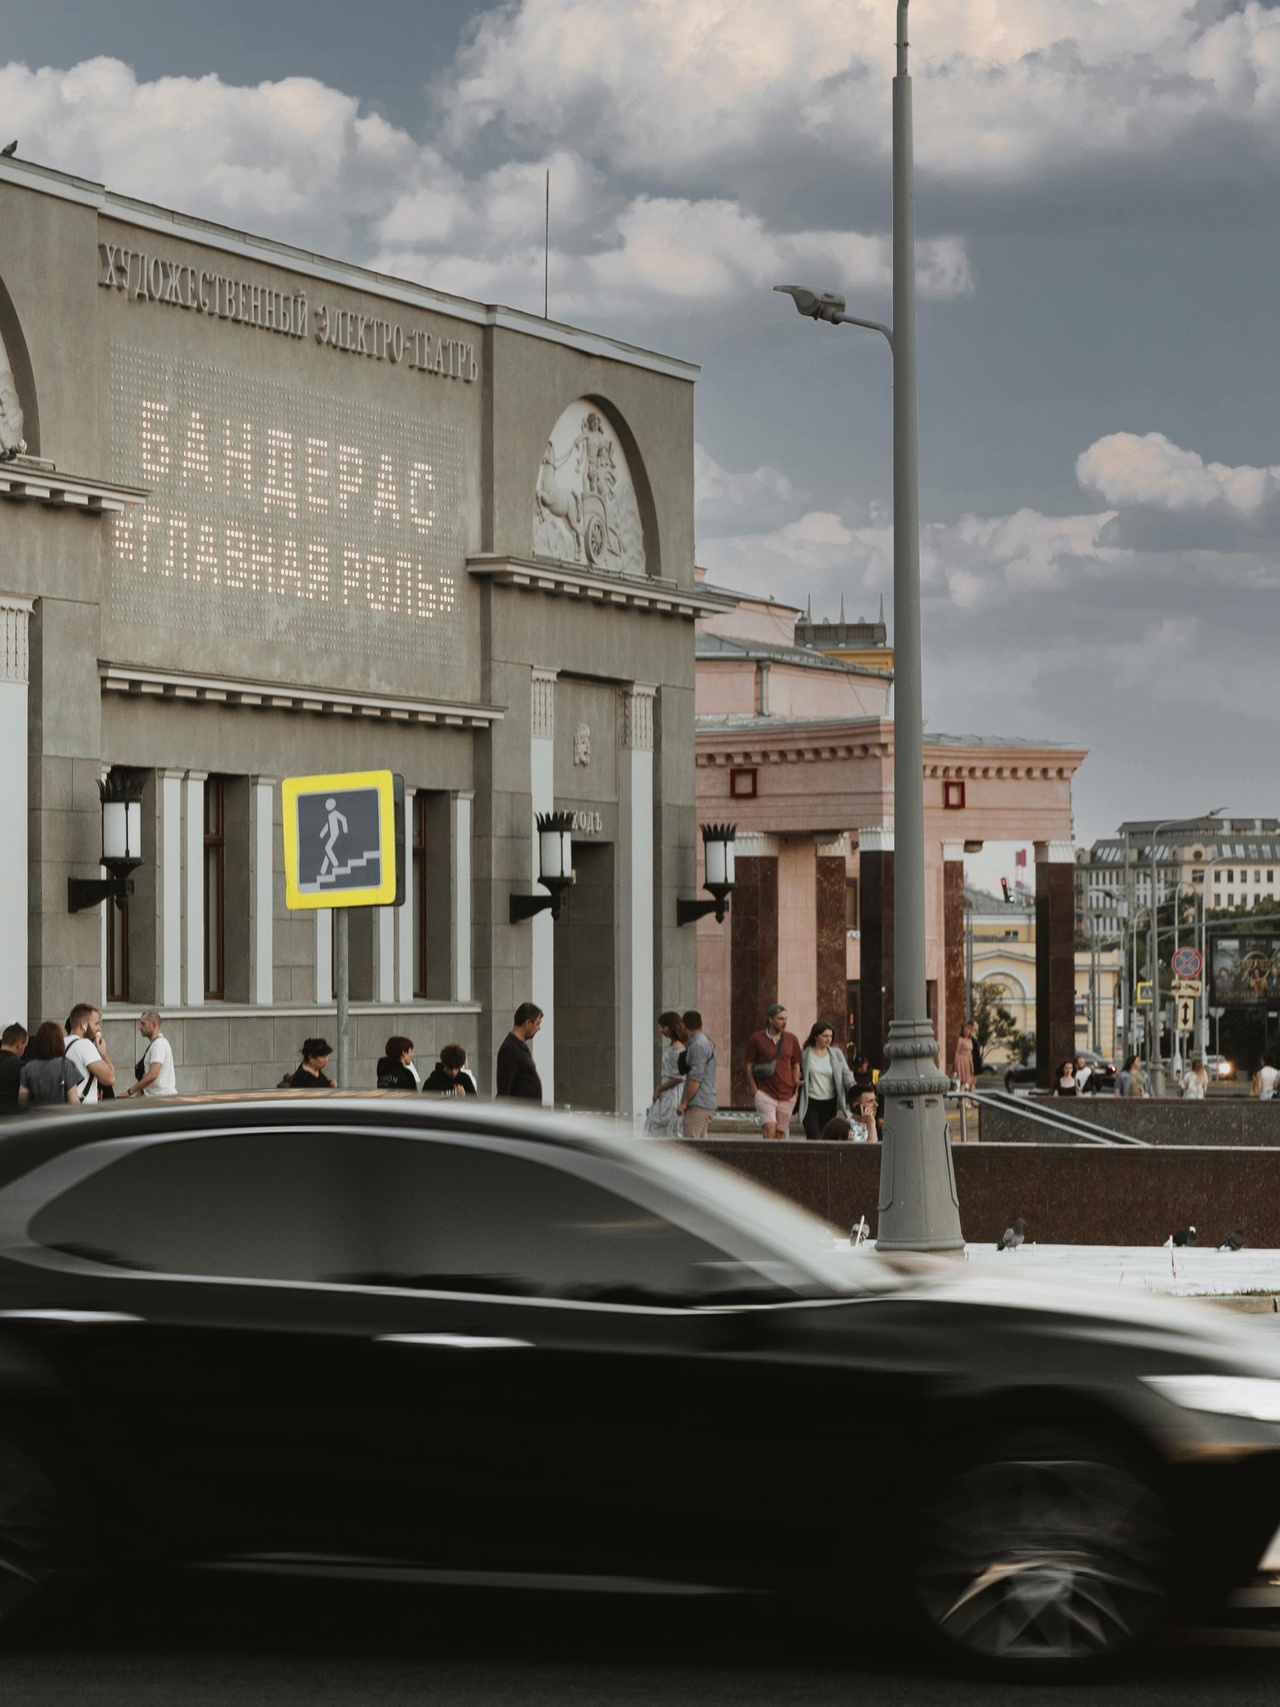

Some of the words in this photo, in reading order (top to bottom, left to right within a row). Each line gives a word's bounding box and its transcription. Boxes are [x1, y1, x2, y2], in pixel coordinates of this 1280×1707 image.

[103, 243, 309, 337] ХУДОЖЕСТВЕННЫЙ
[318, 303, 479, 382] ЭЛЕКТРО-ТЕАТРЪ
[141, 400, 436, 535] БАНДЕРАС
